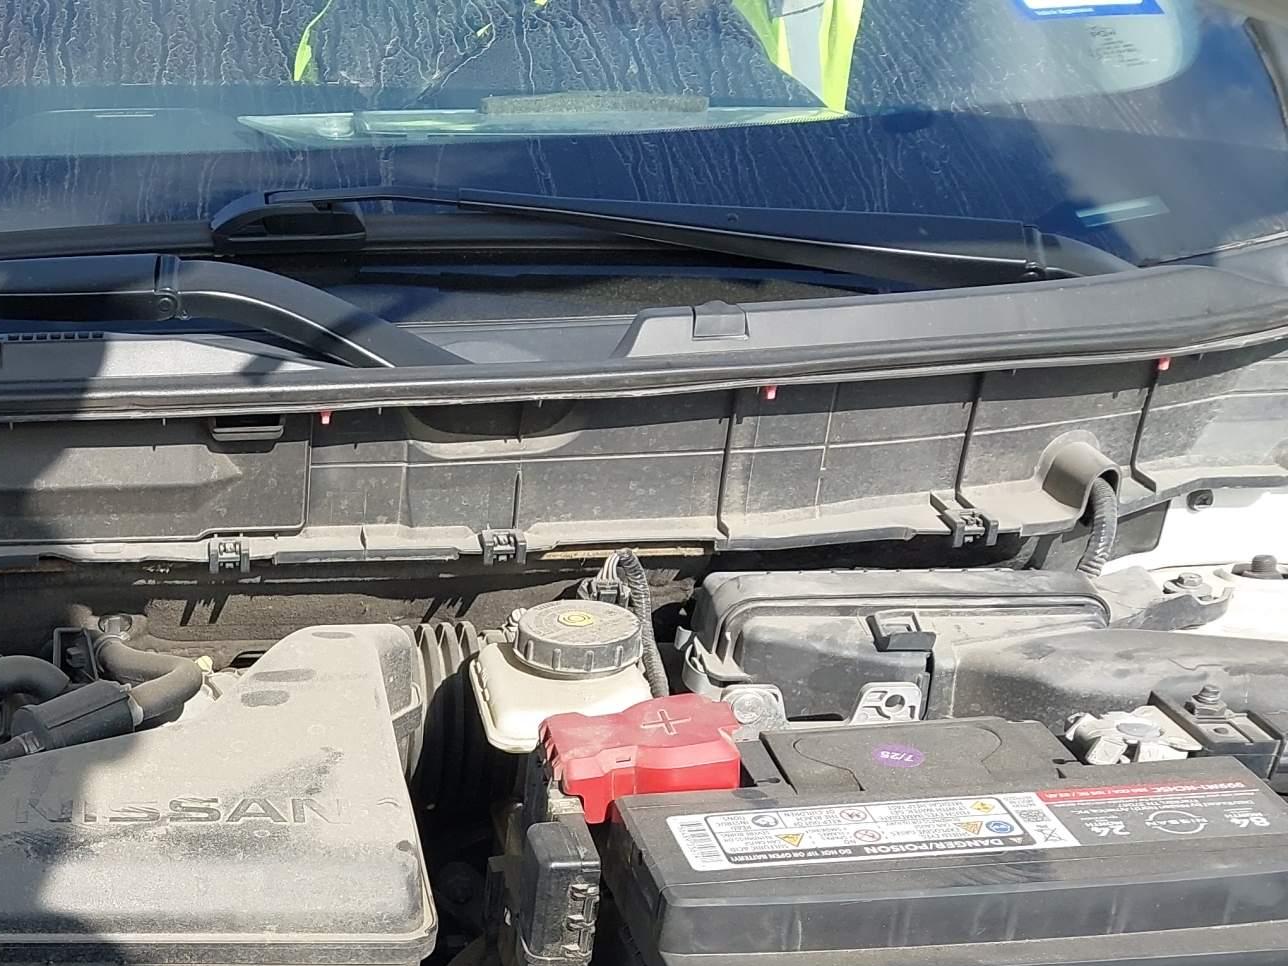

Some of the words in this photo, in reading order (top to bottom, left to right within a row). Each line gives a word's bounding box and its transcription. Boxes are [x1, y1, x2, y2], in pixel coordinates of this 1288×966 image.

[880, 751, 914, 762] 7/25
[15, 798, 349, 825] NISSAN
[1145, 817, 1208, 826] NISSAN
[1230, 816, 1270, 828] 84
[1091, 825, 1131, 836] 24
[864, 838, 1004, 854] DANGER/POISON
[768, 852, 791, 860] OPEN
[806, 850, 819, 858] TIP
